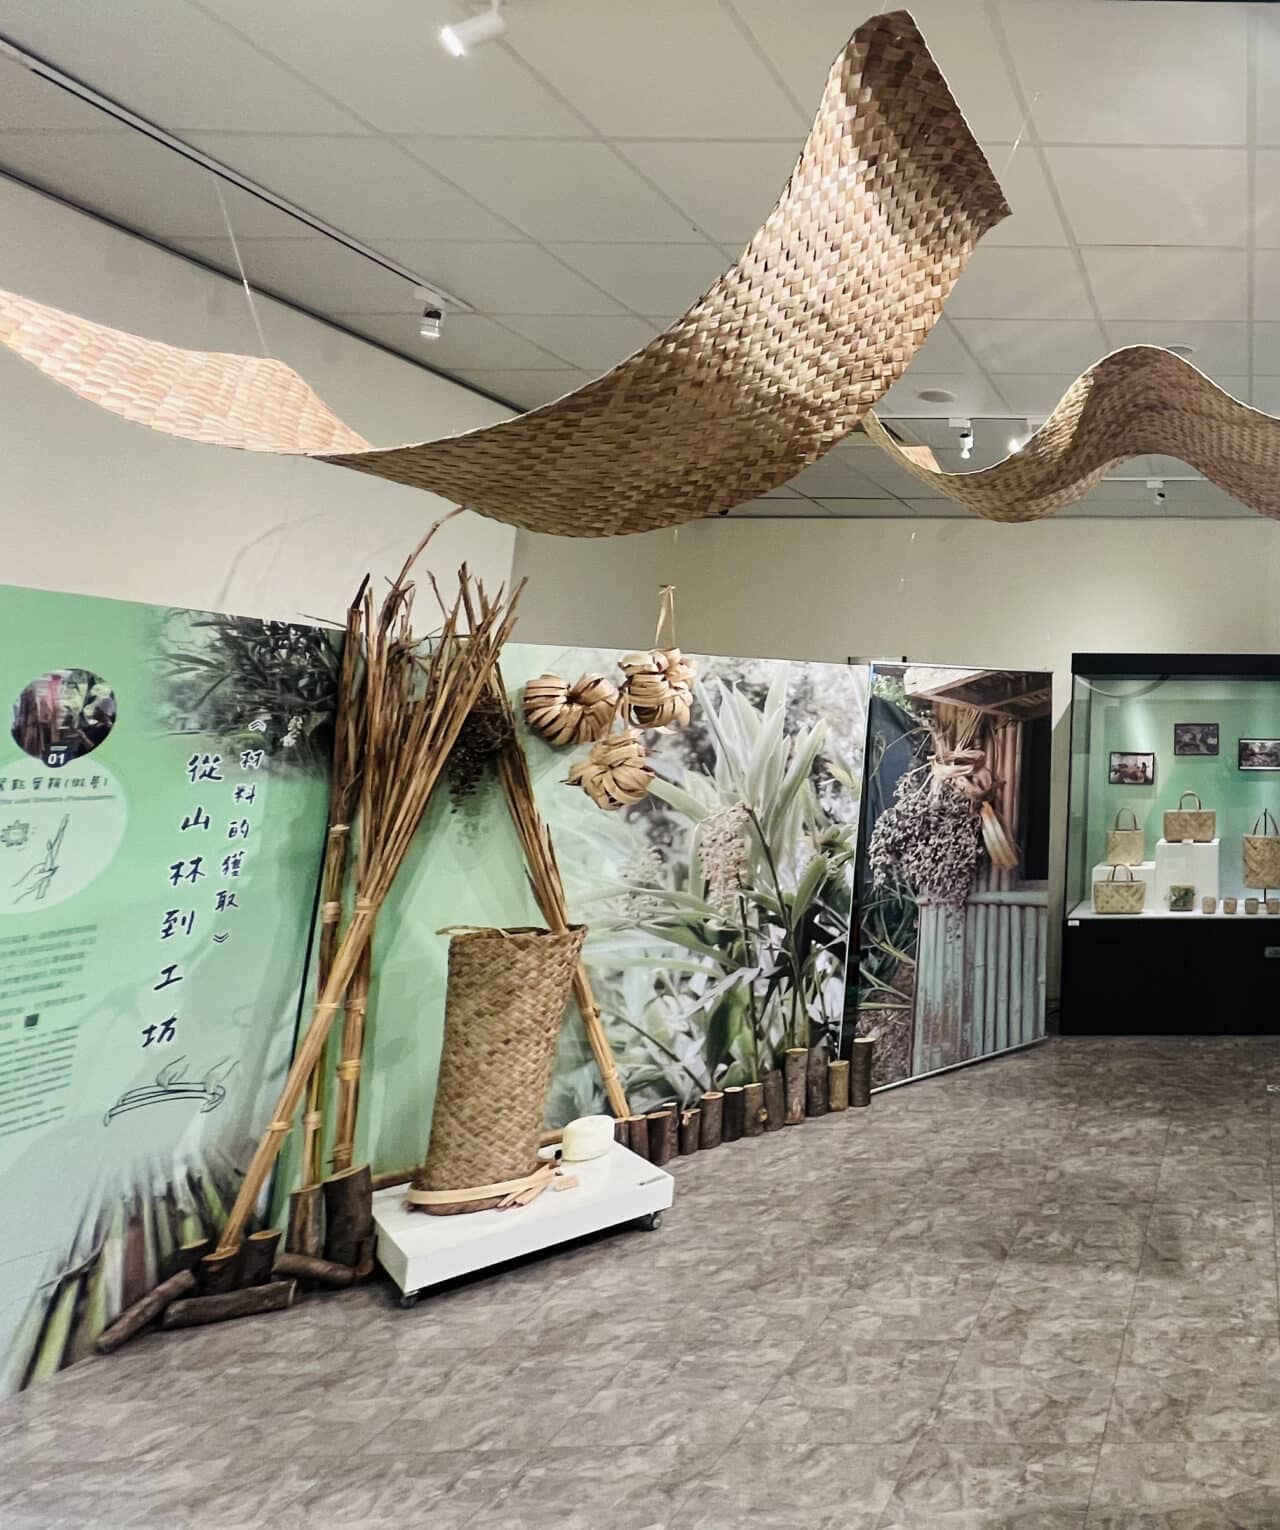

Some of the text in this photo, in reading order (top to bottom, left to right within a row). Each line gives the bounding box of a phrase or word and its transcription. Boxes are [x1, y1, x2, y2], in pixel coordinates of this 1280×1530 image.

[47, 753, 65, 765] 01
[141, 754, 223, 1048] 從山林到工坊
